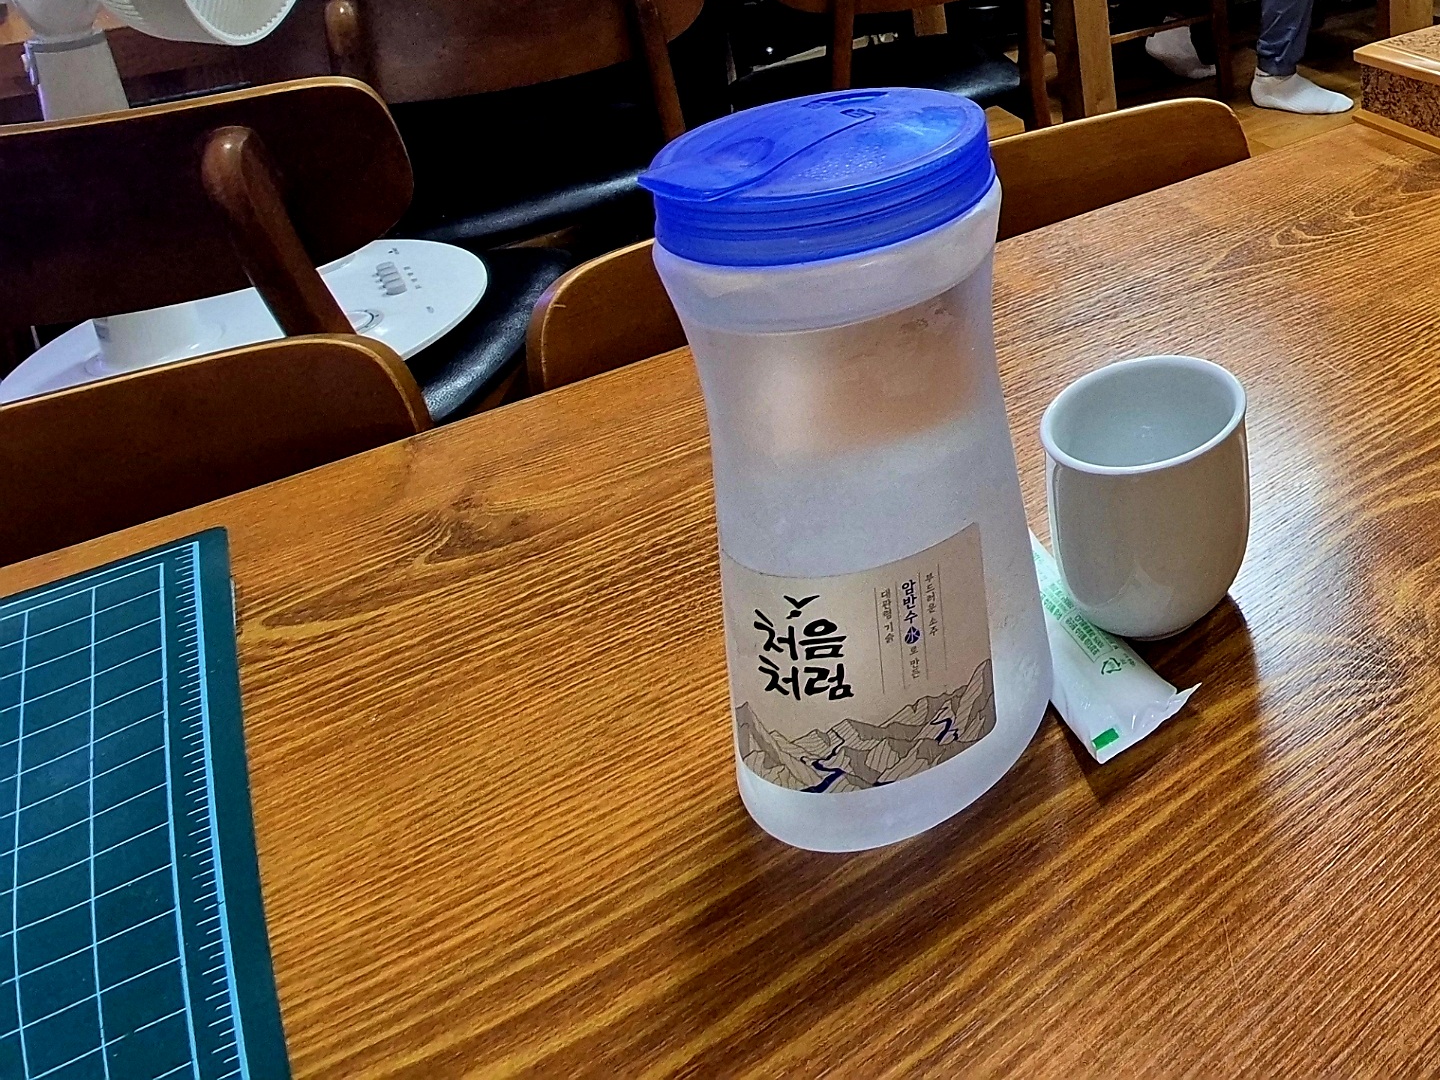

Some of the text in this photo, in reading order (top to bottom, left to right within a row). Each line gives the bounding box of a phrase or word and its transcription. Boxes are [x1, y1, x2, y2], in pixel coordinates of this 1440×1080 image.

[881, 587, 892, 620] 대관령
[925, 572, 939, 636] 부드러운 소주
[753, 608, 848, 661] 처음
[758, 654, 855, 701] 처럼
[909, 658, 921, 679] 만든
